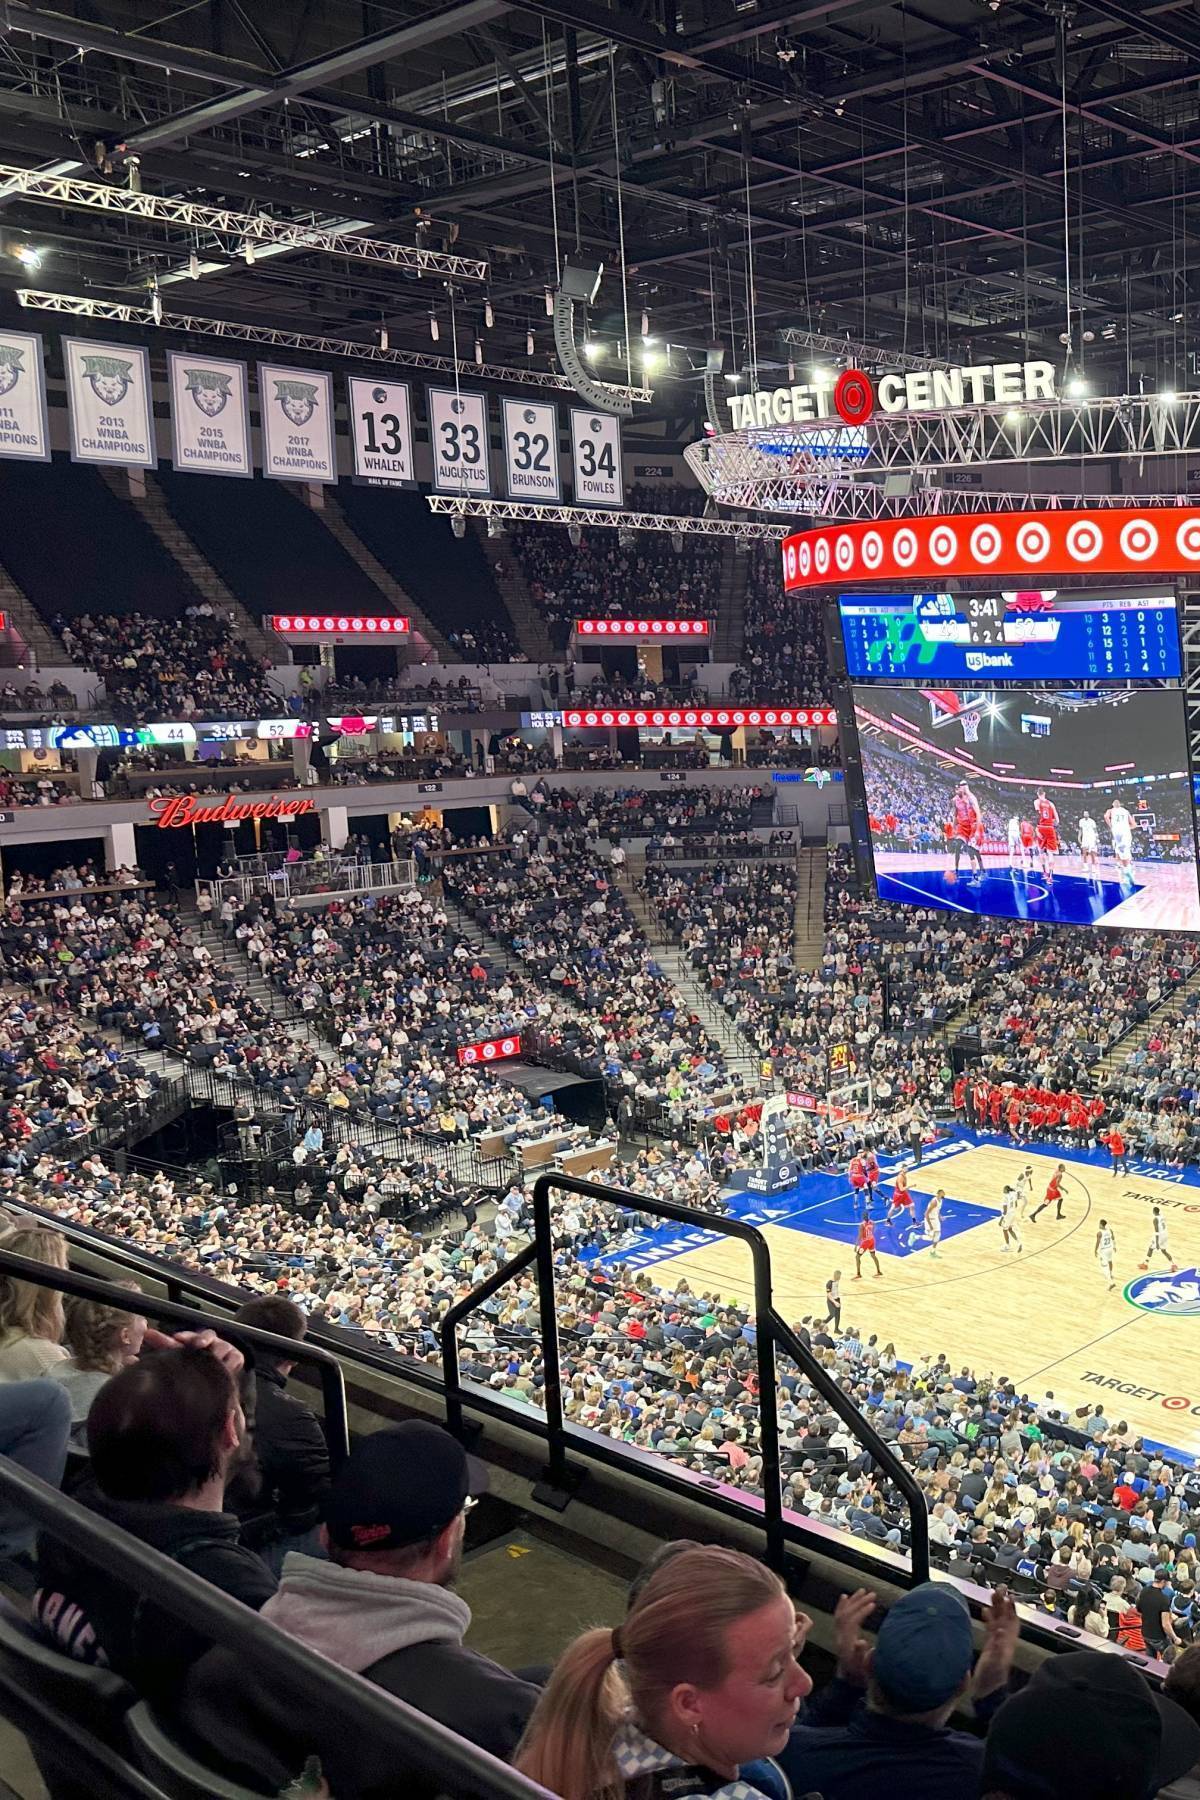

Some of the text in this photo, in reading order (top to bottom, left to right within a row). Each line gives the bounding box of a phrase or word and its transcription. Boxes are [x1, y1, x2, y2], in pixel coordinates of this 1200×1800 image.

[727, 361, 1055, 430] TARGET CENTER
[0, 408, 13, 418] 11
[99, 416, 124, 427] 2013
[97, 428, 129, 440] WNBA
[200, 427, 223, 438] 2015
[362, 412, 402, 454] 13
[82, 438, 145, 453] CHAMPIONS
[197, 438, 227, 450] WNBA
[288, 435, 309, 446] 2017
[440, 422, 480, 463] 33
[183, 448, 242, 463] CHAMPIONS
[285, 446, 313, 457] WNBA
[513, 431, 550, 472] 32
[273, 456, 327, 470] CHAMPIONS
[364, 457, 404, 472] WHALEN
[580, 440, 616, 478] 34
[439, 466, 485, 480] AUGUSTUS
[645, 467, 662, 476] 224
[512, 473, 554, 488] BRUNSON
[956, 474, 972, 483] 226
[583, 481, 614, 494] FOWLES
[969, 599, 998, 617] 3:41
[861, 618, 866, 626] 4
[872, 618, 877, 627] 2
[884, 618, 888, 626] 1
[1084, 611, 1163, 623] 13 3 3 0 0
[862, 630, 867, 638] 5
[874, 630, 879, 638] 4
[1087, 624, 1164, 635] 9 12 2 2 0
[973, 631, 1003, 643] 6 2 4
[1088, 640, 1094, 648] 6
[1103, 638, 1113, 648] 15
[1122, 638, 1128, 647] 3
[1141, 638, 1145, 647] 1
[887, 641, 892, 650] 3
[968, 652, 1014, 667] us bank
[1088, 652, 1094, 661] 11
[1106, 651, 1112, 660] 8
[1141, 650, 1147, 660] 3
[1159, 650, 1166, 659] 0
[867, 663, 895, 673] 4 2
[1089, 664, 1097, 673] 12
[1107, 663, 1113, 672] 5
[1124, 663, 1131, 672] 2
[1142, 662, 1149, 672] 4
[167, 729, 184, 739] 44
[212, 724, 243, 737] 3:41
[270, 726, 284, 736] 52
[150, 795, 314, 828] Budweiser
[831, 1053, 847, 1067] 24
[772, 1176, 798, 1189] CFMOTO
[1122, 1191, 1185, 1208] TARGET
[1080, 1371, 1165, 1400] TARGET
